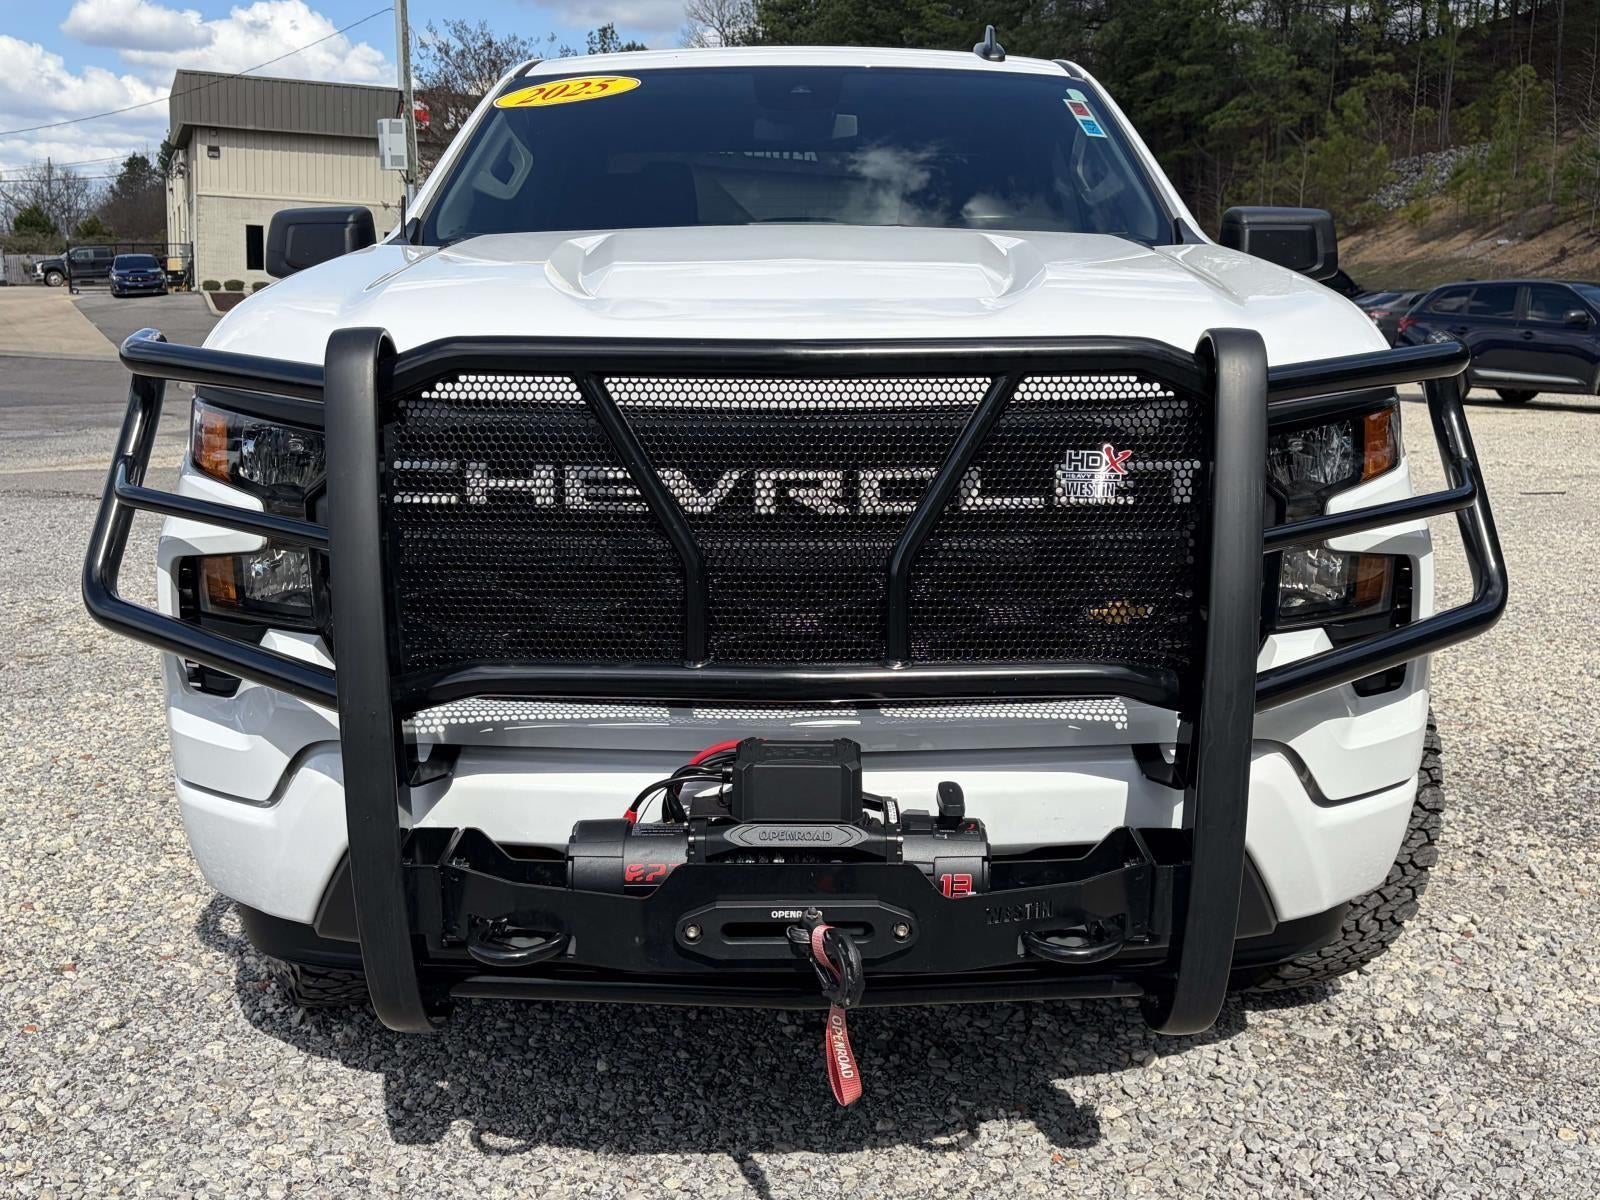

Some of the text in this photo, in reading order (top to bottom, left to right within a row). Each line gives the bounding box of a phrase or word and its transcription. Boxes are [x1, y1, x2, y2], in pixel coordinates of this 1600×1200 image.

[514, 77, 618, 105] 2025
[1066, 443, 1133, 474] HDX
[759, 829, 833, 842] OPENROAD
[940, 873, 972, 899] 13
[831, 1015, 854, 1079] OPENROAD
